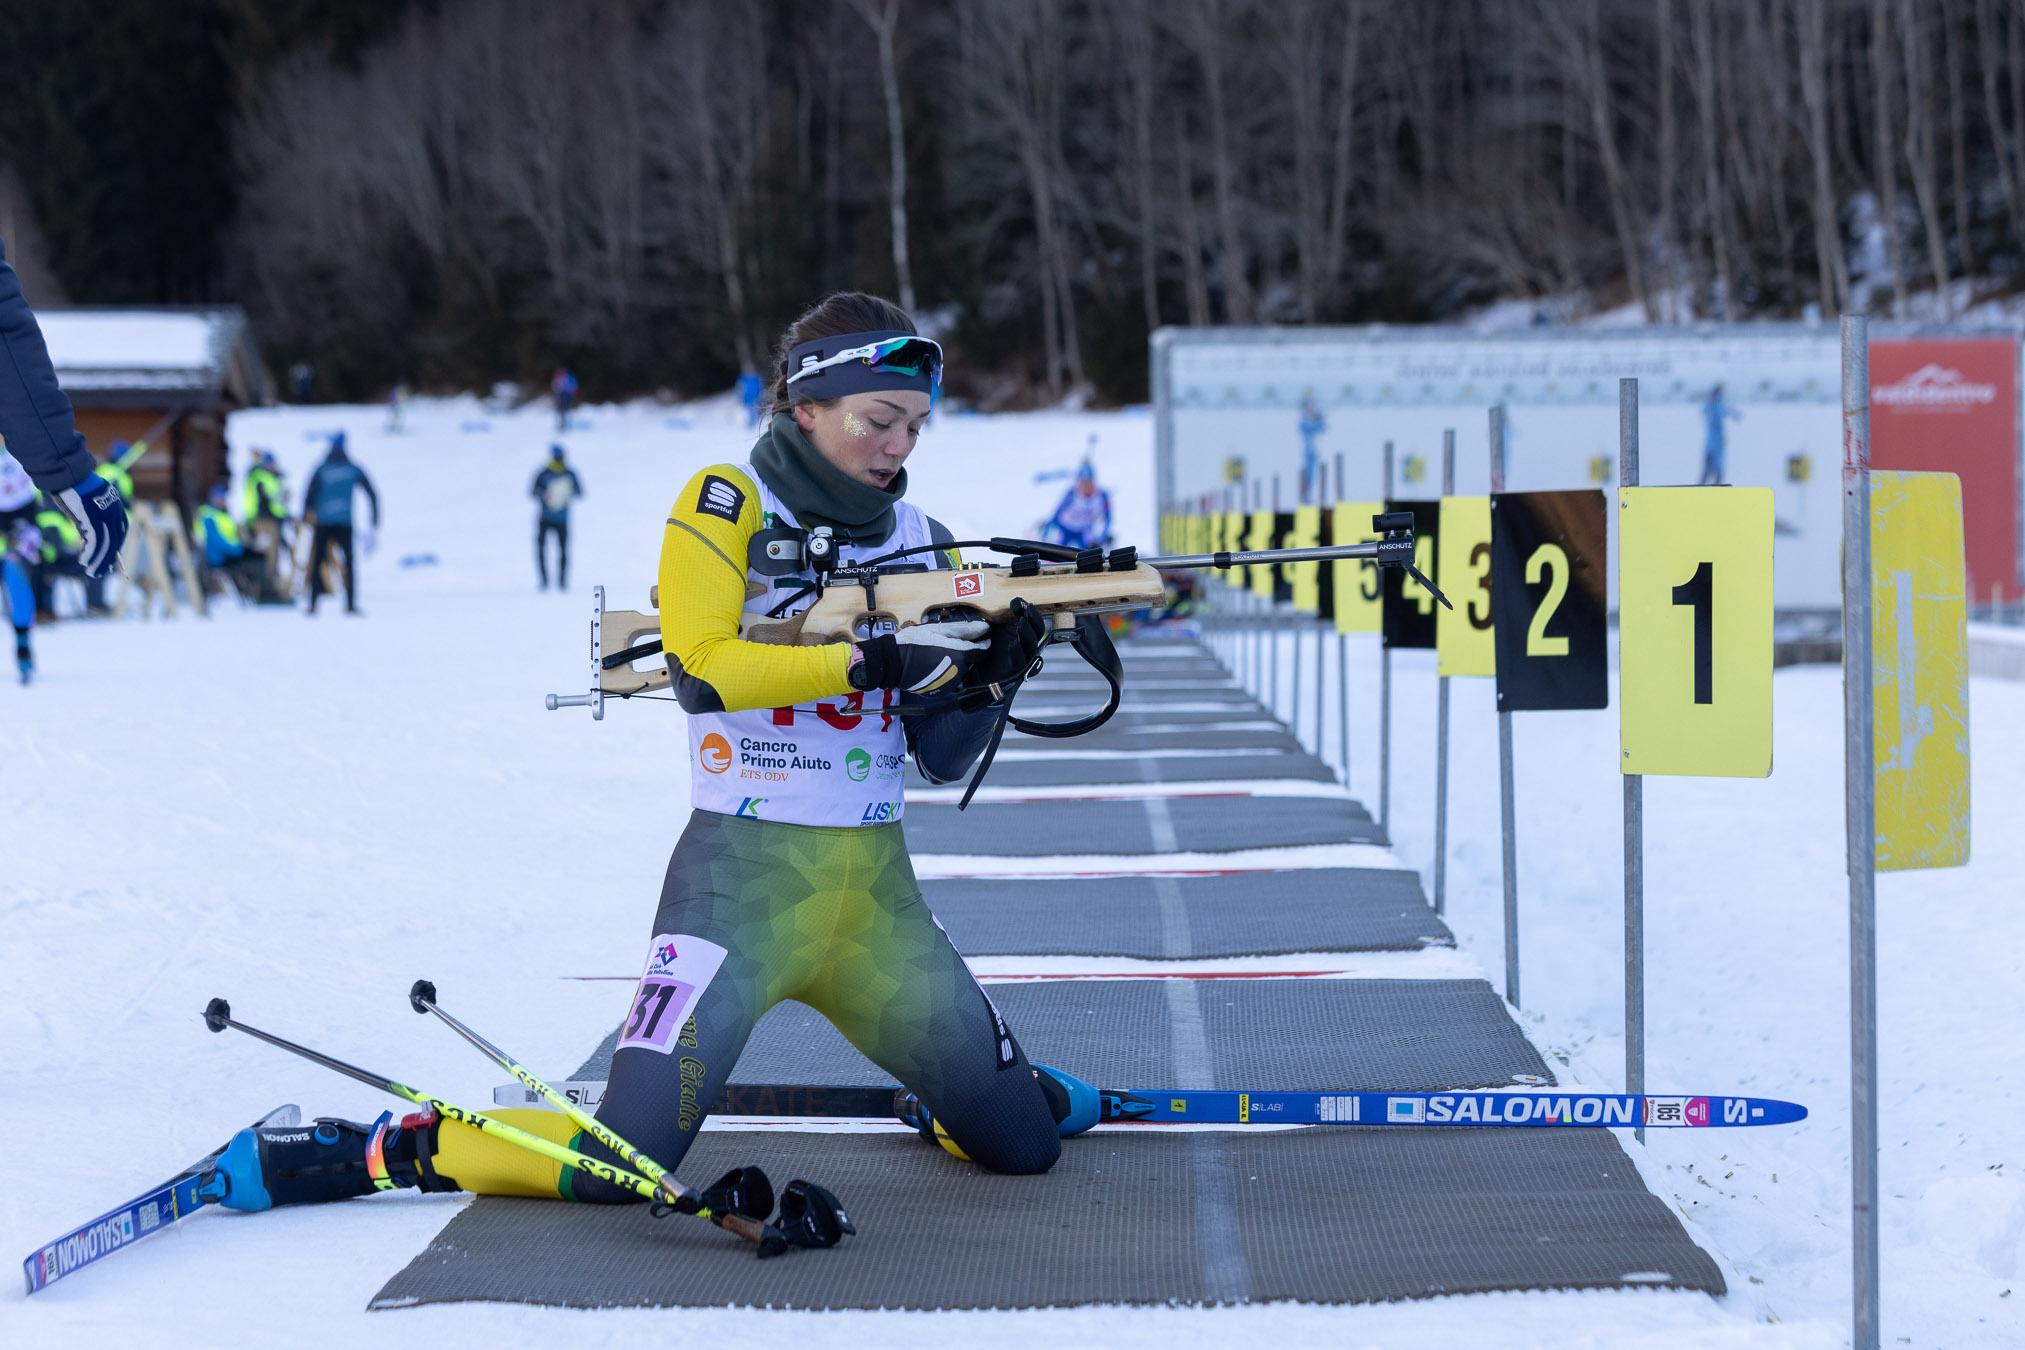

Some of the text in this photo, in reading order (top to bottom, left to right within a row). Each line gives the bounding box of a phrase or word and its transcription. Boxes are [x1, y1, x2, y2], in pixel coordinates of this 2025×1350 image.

[705, 502, 733, 515] sportful
[834, 566, 878, 575] ANSCHUTZ
[1468, 542, 1494, 631] 3
[1525, 543, 1570, 656] 2
[1672, 562, 1713, 704] 1
[740, 738, 797, 753] Cancro
[740, 769, 790, 782] ETS ODV
[741, 753, 832, 770] Primo Aiuto
[861, 802, 902, 821] LISKI
[624, 983, 677, 1040] 31
[678, 1056, 706, 1132] Gialle
[429, 1099, 489, 1130] RCS
[1426, 1096, 1635, 1124] SALOMON
[1657, 1103, 1680, 1121] 165
[262, 1132, 310, 1143] SALOMON
[577, 1157, 642, 1191] RCS
[58, 1211, 123, 1275] SALOMON
